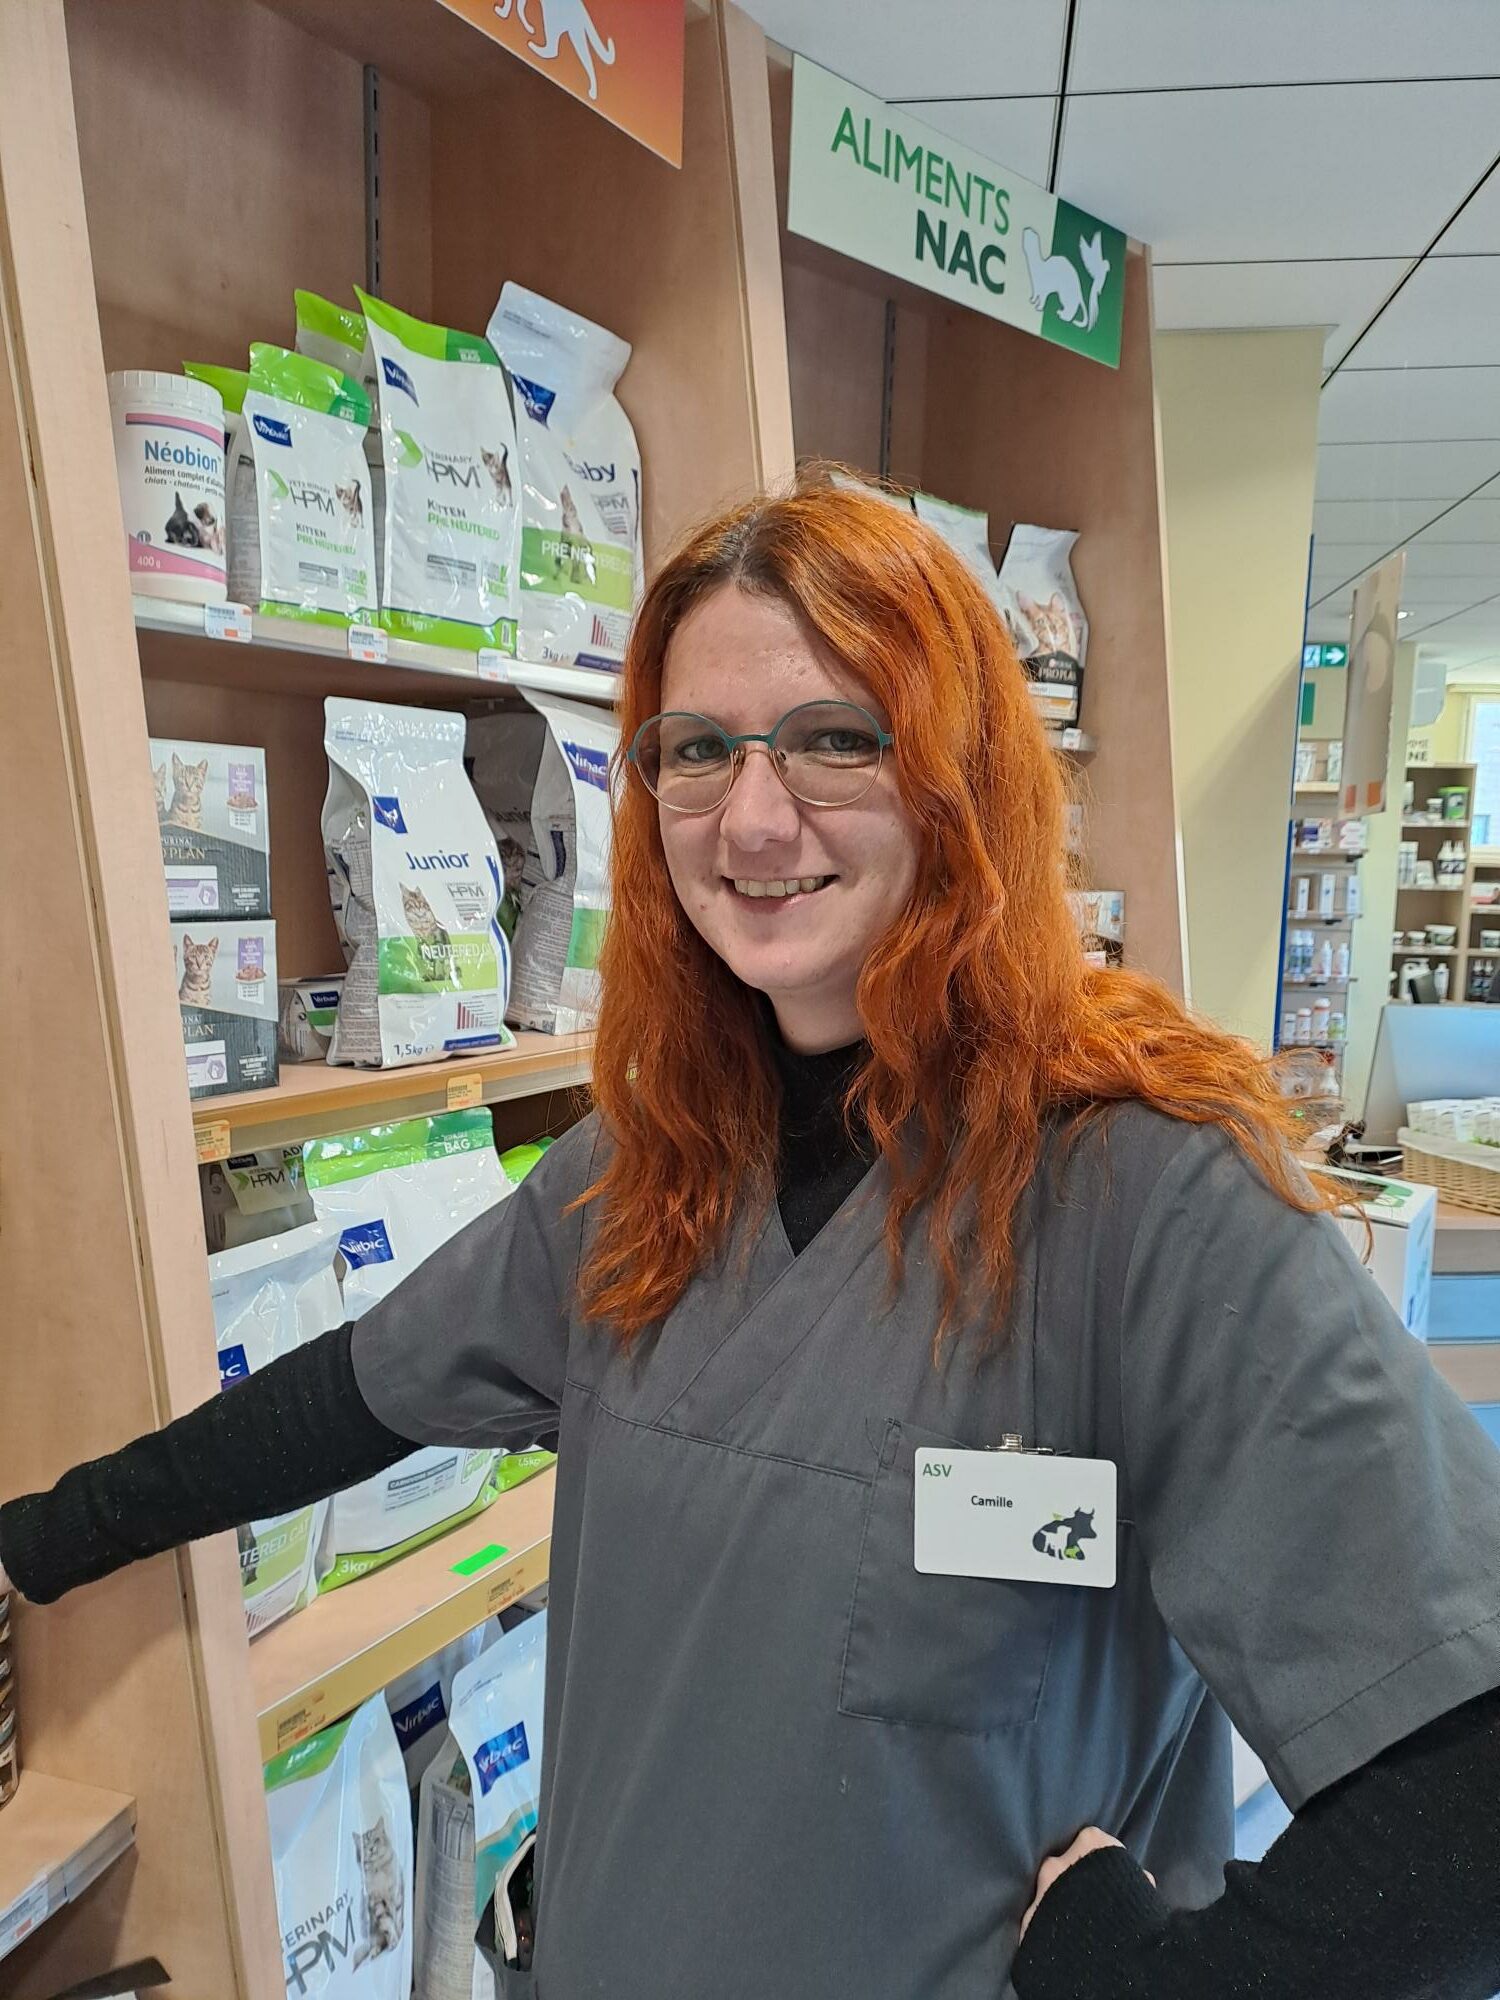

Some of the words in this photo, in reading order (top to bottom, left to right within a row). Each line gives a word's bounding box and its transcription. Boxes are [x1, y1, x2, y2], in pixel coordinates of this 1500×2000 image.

[831, 106, 1010, 236] ALIMENTS
[915, 208, 1006, 295] NAC
[144, 439, 218, 474] Néobion
[290, 486, 336, 517] HPM
[541, 539, 570, 558] PRE
[137, 556, 155, 568] 400
[169, 847, 206, 861] PLAN
[405, 849, 470, 871] Junior
[447, 885, 486, 898] HPM
[251, 1170, 286, 1189] HPM
[922, 1463, 952, 1478] ASV
[971, 1495, 1013, 1509] Camille
[242, 1534, 287, 1567] TERED
[284, 1888, 350, 1948] ERINARY
[286, 1906, 356, 1996] PM
